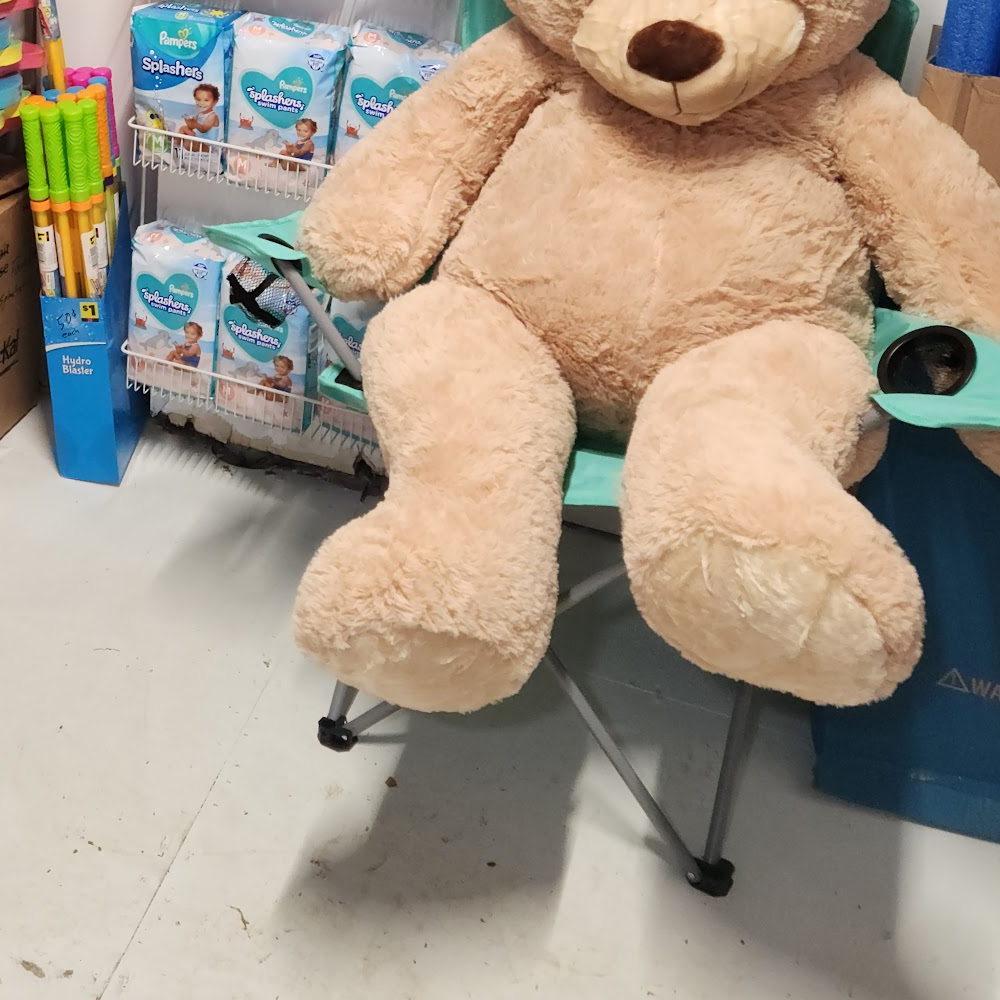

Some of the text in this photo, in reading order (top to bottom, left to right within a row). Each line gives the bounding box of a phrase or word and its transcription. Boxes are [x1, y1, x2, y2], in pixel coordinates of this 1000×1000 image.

[159, 30, 198, 50] Pampers
[142, 57, 204, 81] Splashers
[279, 81, 308, 94] Pampers
[246, 85, 305, 110] splashers
[257, 99, 299, 114] swim pants
[169, 283, 195, 299] Pampers
[141, 287, 192, 313] splashers
[82, 304, 96, 318] $1
[150, 302, 188, 317] swim pants
[62, 327, 81, 339] each
[228, 320, 282, 349] splashers
[62, 354, 92, 367] Hydro
[62, 364, 94, 376] Blaster
